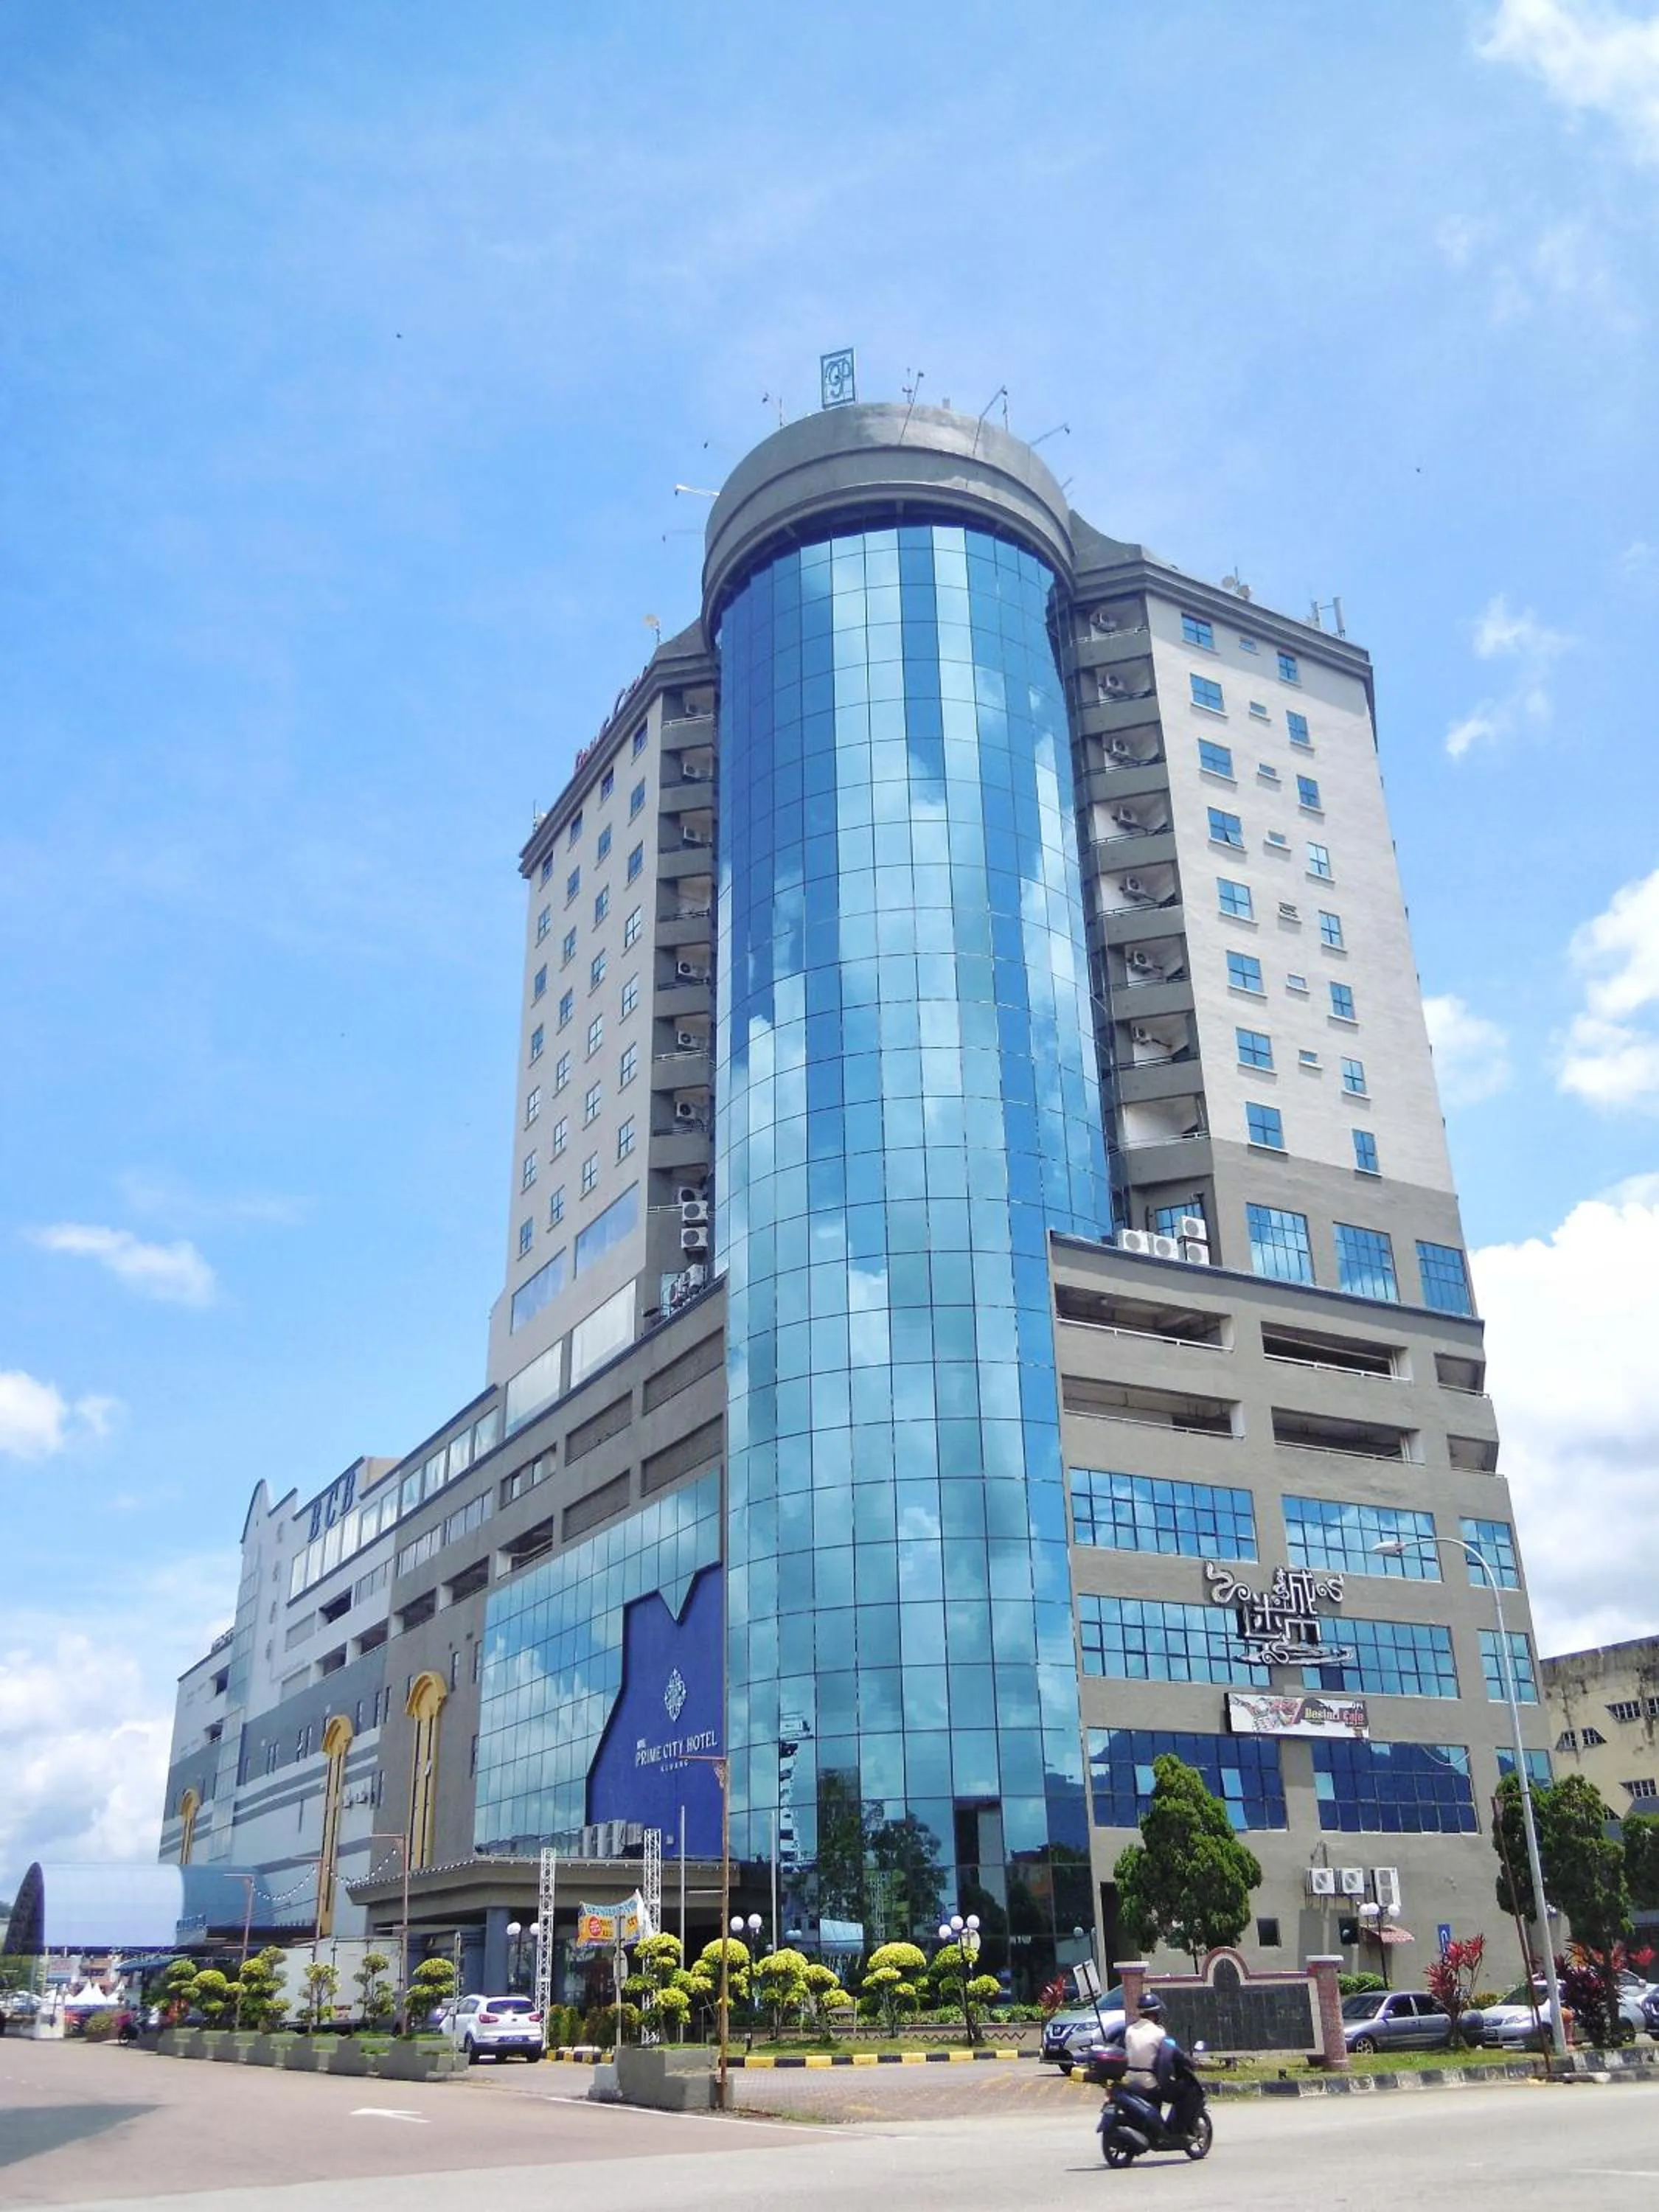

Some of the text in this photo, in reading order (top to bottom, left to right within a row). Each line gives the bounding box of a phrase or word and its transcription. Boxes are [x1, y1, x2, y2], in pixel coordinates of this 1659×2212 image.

[636, 1745, 661, 1768] PRIME
[663, 1739, 683, 1759] CITY
[686, 1730, 717, 1753] HOTEL
